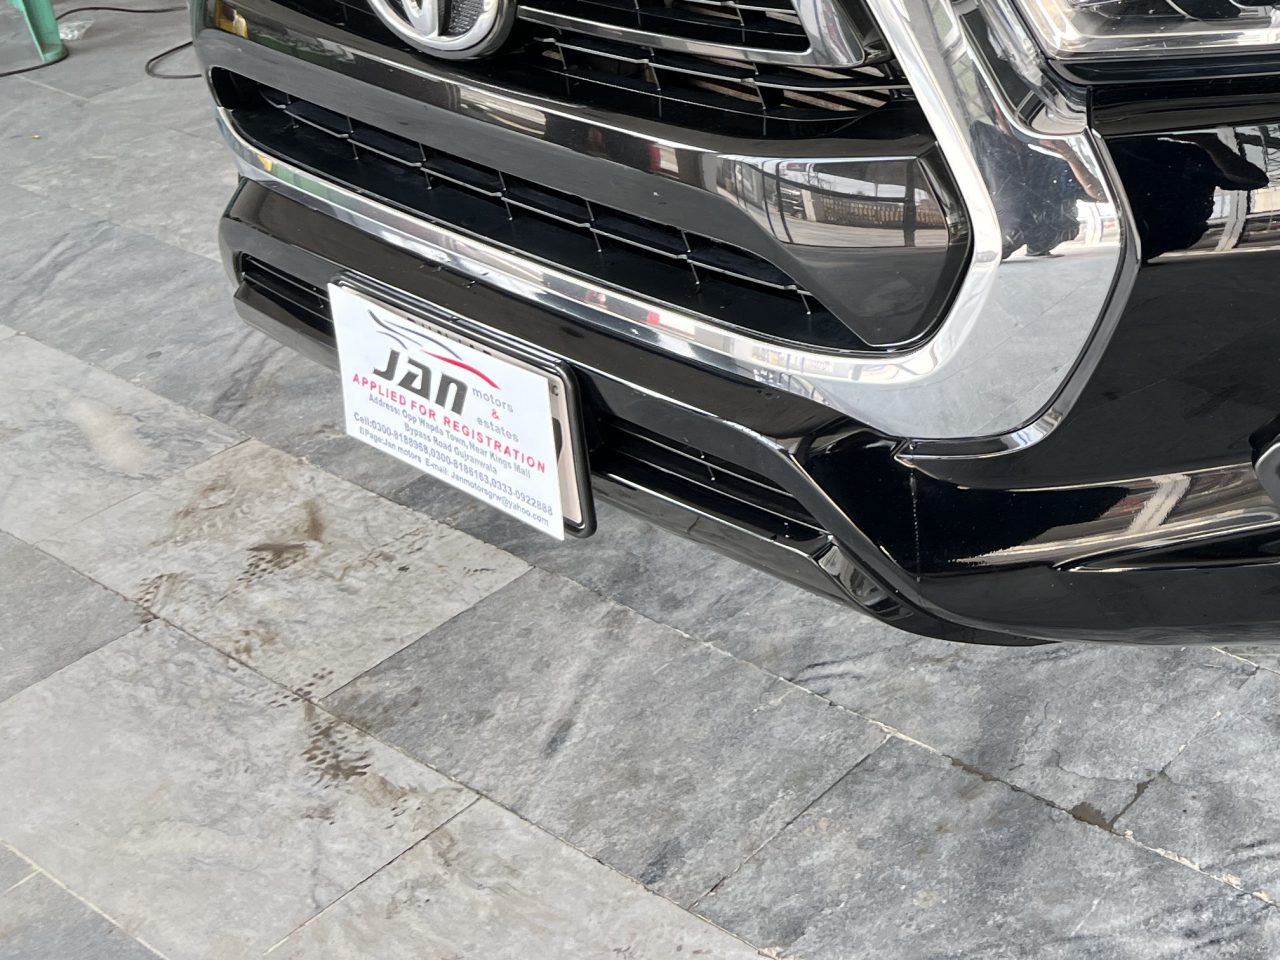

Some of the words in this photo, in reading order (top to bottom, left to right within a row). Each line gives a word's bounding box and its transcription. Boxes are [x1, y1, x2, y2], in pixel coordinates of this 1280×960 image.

[369, 393, 401, 416] Address:
[402, 409, 417, 425] Opp
[472, 387, 514, 413] motors
[491, 408, 500, 420] &
[352, 373, 407, 406] APPLIED
[410, 400, 437, 421] FOR
[443, 415, 545, 473] REGISTRATION
[476, 417, 520, 442] estates
[404, 422, 431, 443] Bypass
[432, 435, 452, 452] Road
[454, 446, 498, 474] Gujranwala
